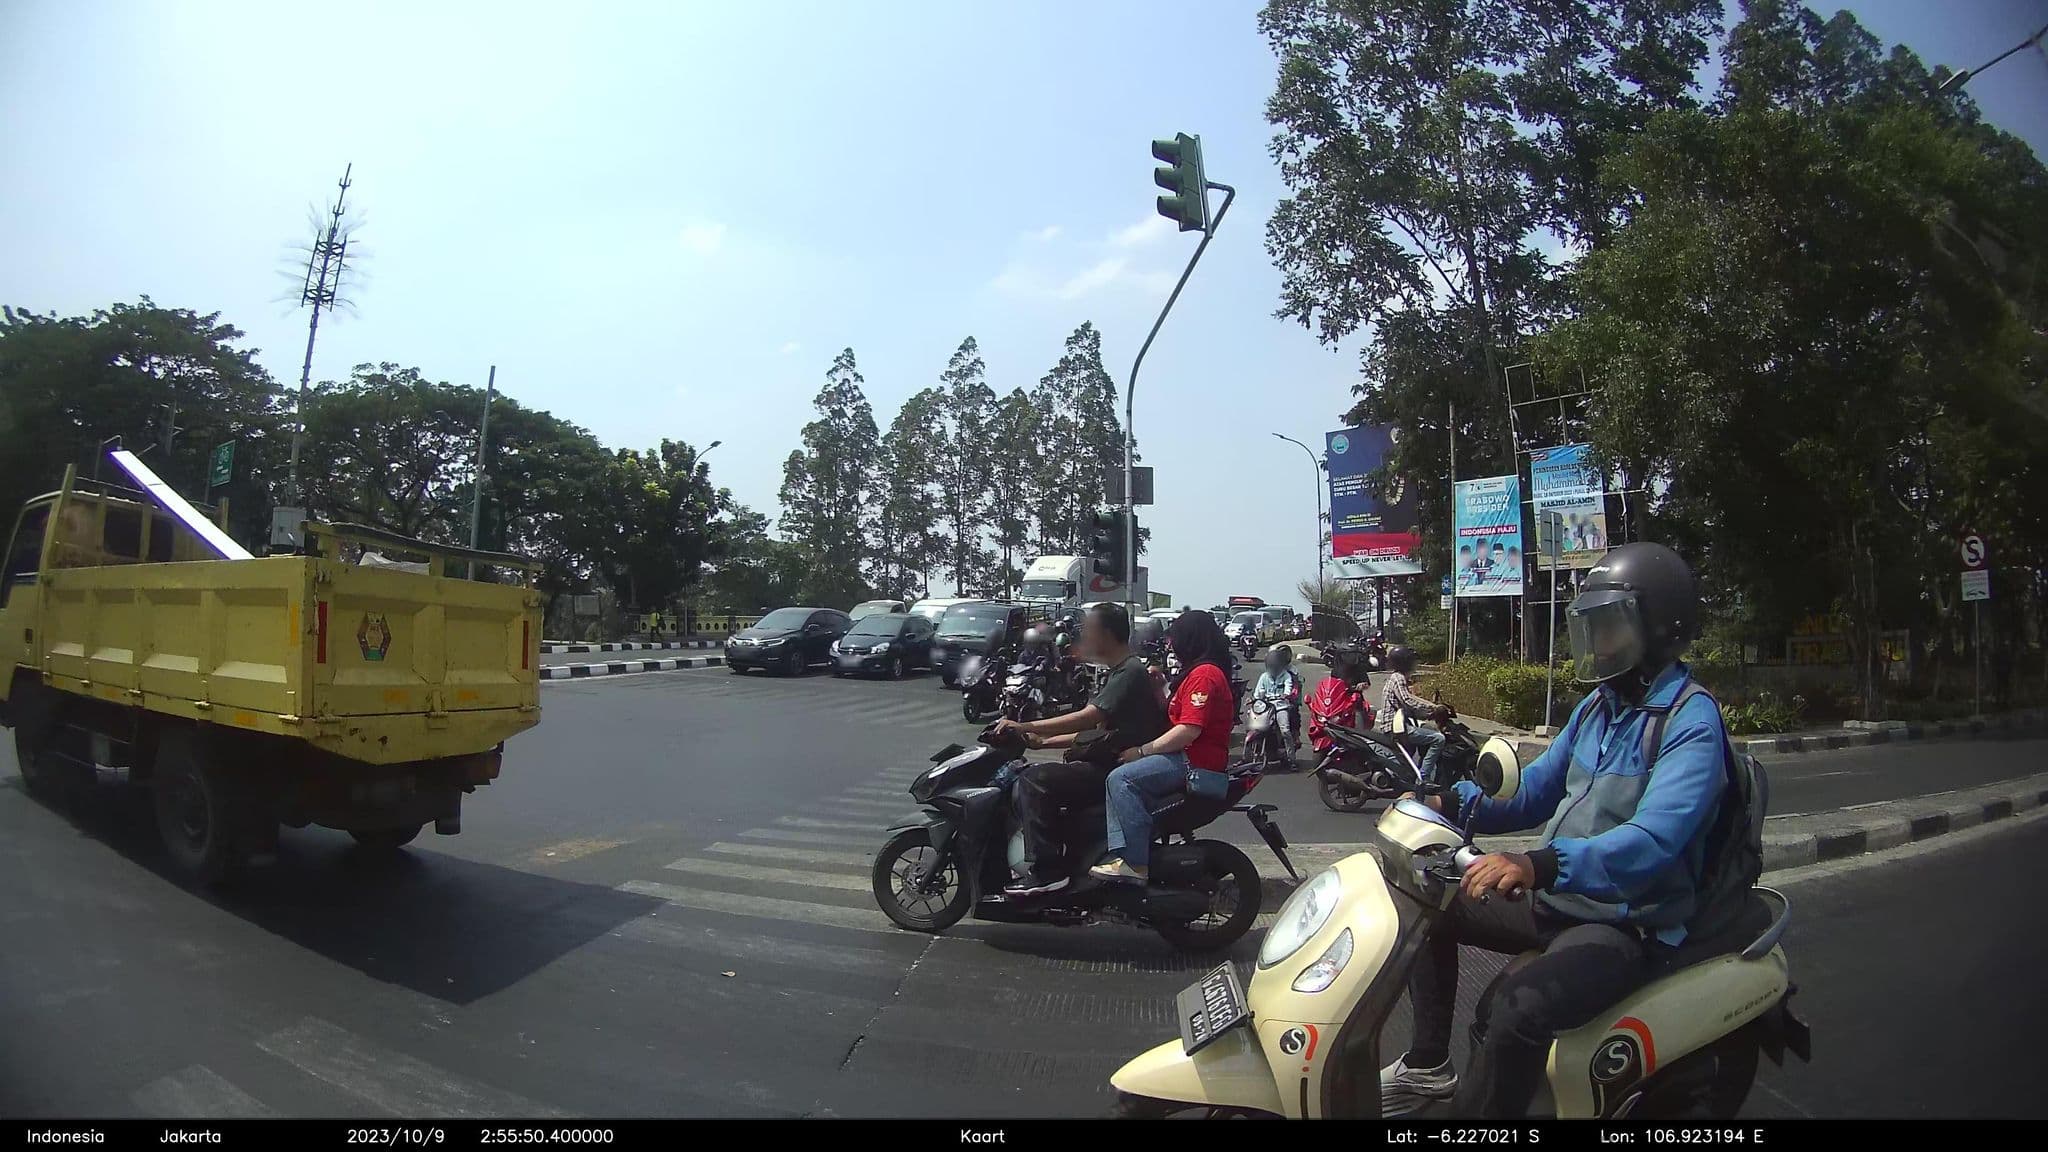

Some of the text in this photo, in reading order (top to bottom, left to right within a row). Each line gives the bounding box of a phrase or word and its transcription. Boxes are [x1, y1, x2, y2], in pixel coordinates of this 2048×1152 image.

[1465, 495, 1509, 506] PRABOWO
[1567, 497, 1595, 505] AL-AMIN
[1461, 528, 1496, 536] INDONESIA
[1608, 1040, 1628, 1075] S
